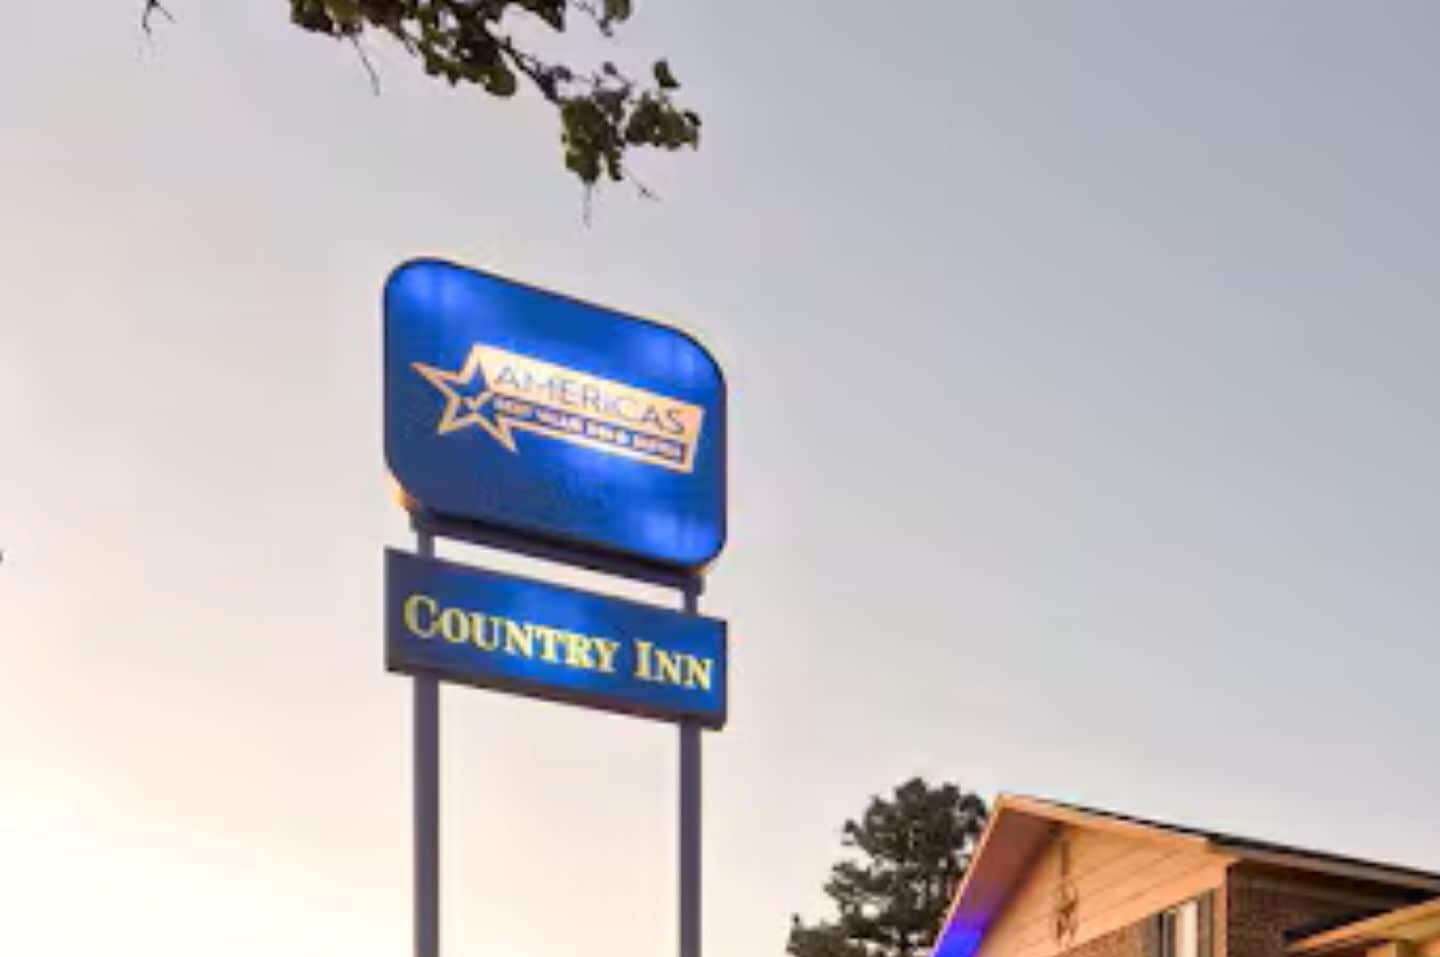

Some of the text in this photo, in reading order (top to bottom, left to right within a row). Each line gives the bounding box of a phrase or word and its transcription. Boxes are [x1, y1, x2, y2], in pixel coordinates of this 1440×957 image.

[494, 365, 685, 434] AMERICAS
[403, 594, 715, 691] COUNTRY INN
